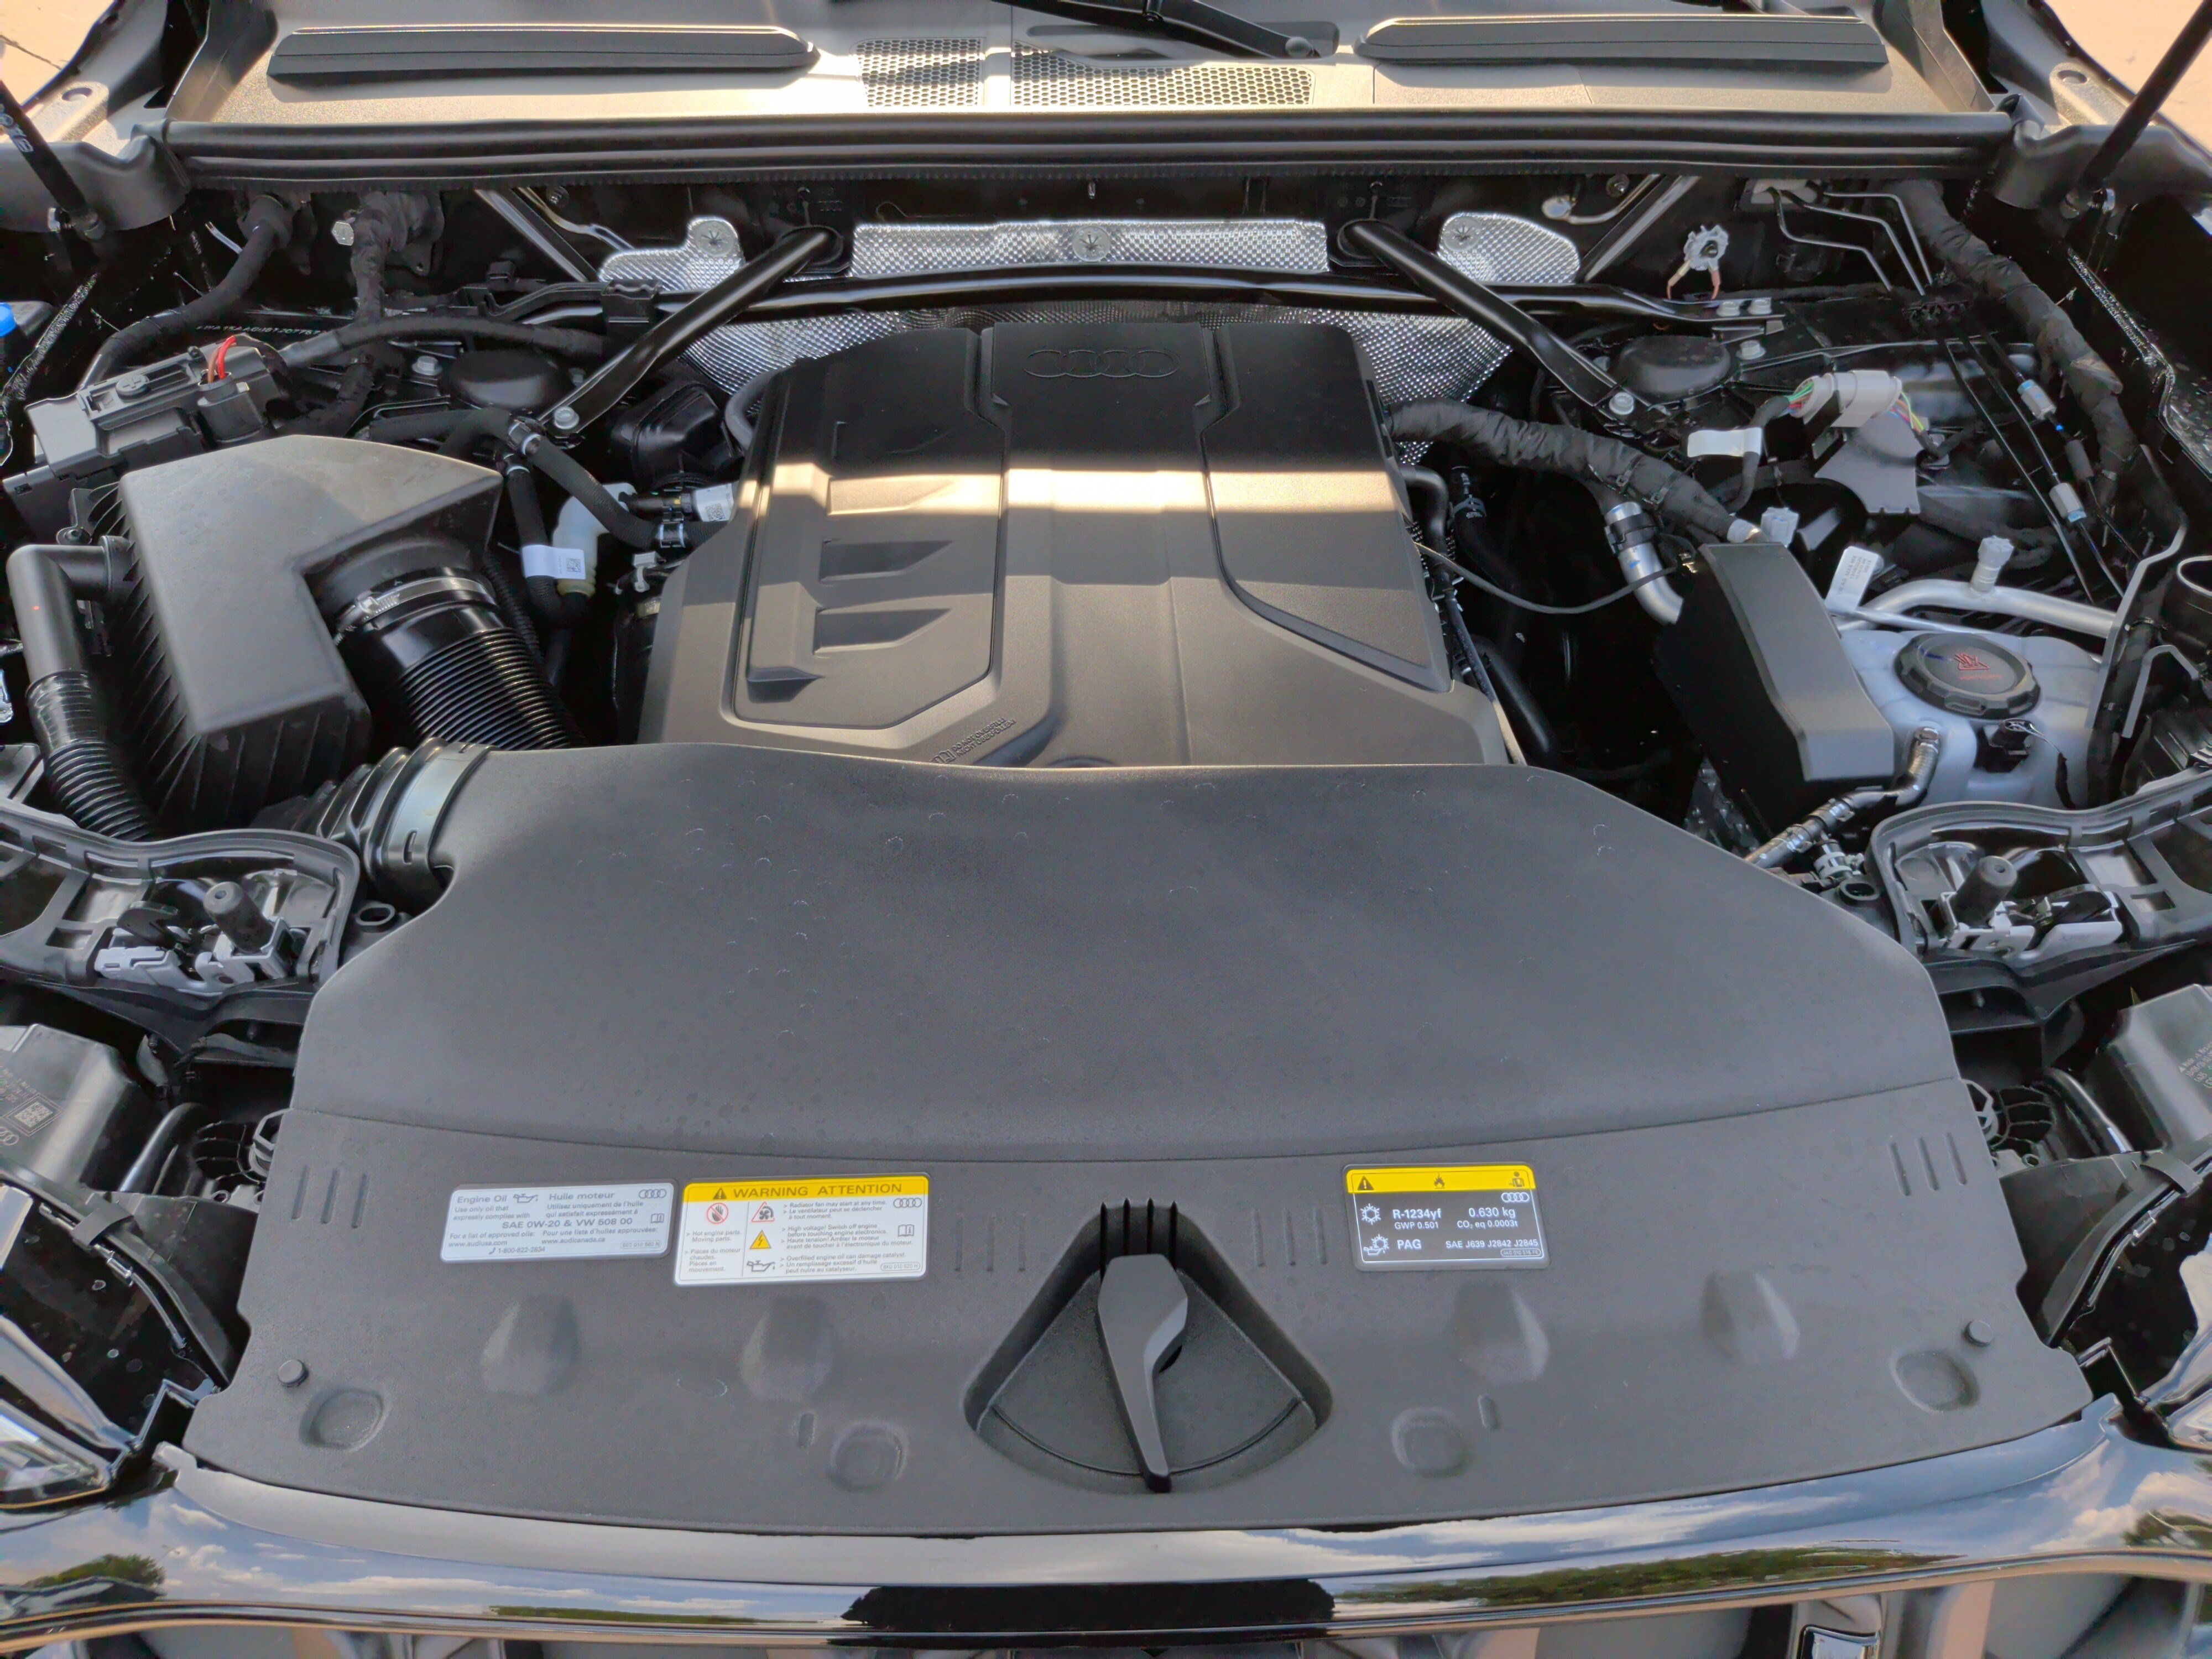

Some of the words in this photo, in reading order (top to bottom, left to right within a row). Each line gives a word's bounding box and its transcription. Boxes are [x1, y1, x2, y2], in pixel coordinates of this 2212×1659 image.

[962, 734, 974, 745] NOT
[733, 1187, 807, 1197] WARNING
[818, 1183, 902, 1194] ATTENTION
[457, 1196, 491, 1204] Engine
[1392, 1208, 1442, 1220] R-1234yf
[1468, 1207, 1499, 1217] 0.630
[1502, 1207, 1516, 1218] kg
[526, 1220, 560, 1228] 0W-20
[1397, 1239, 1422, 1250] PAG
[1446, 1240, 1463, 1249] SAE
